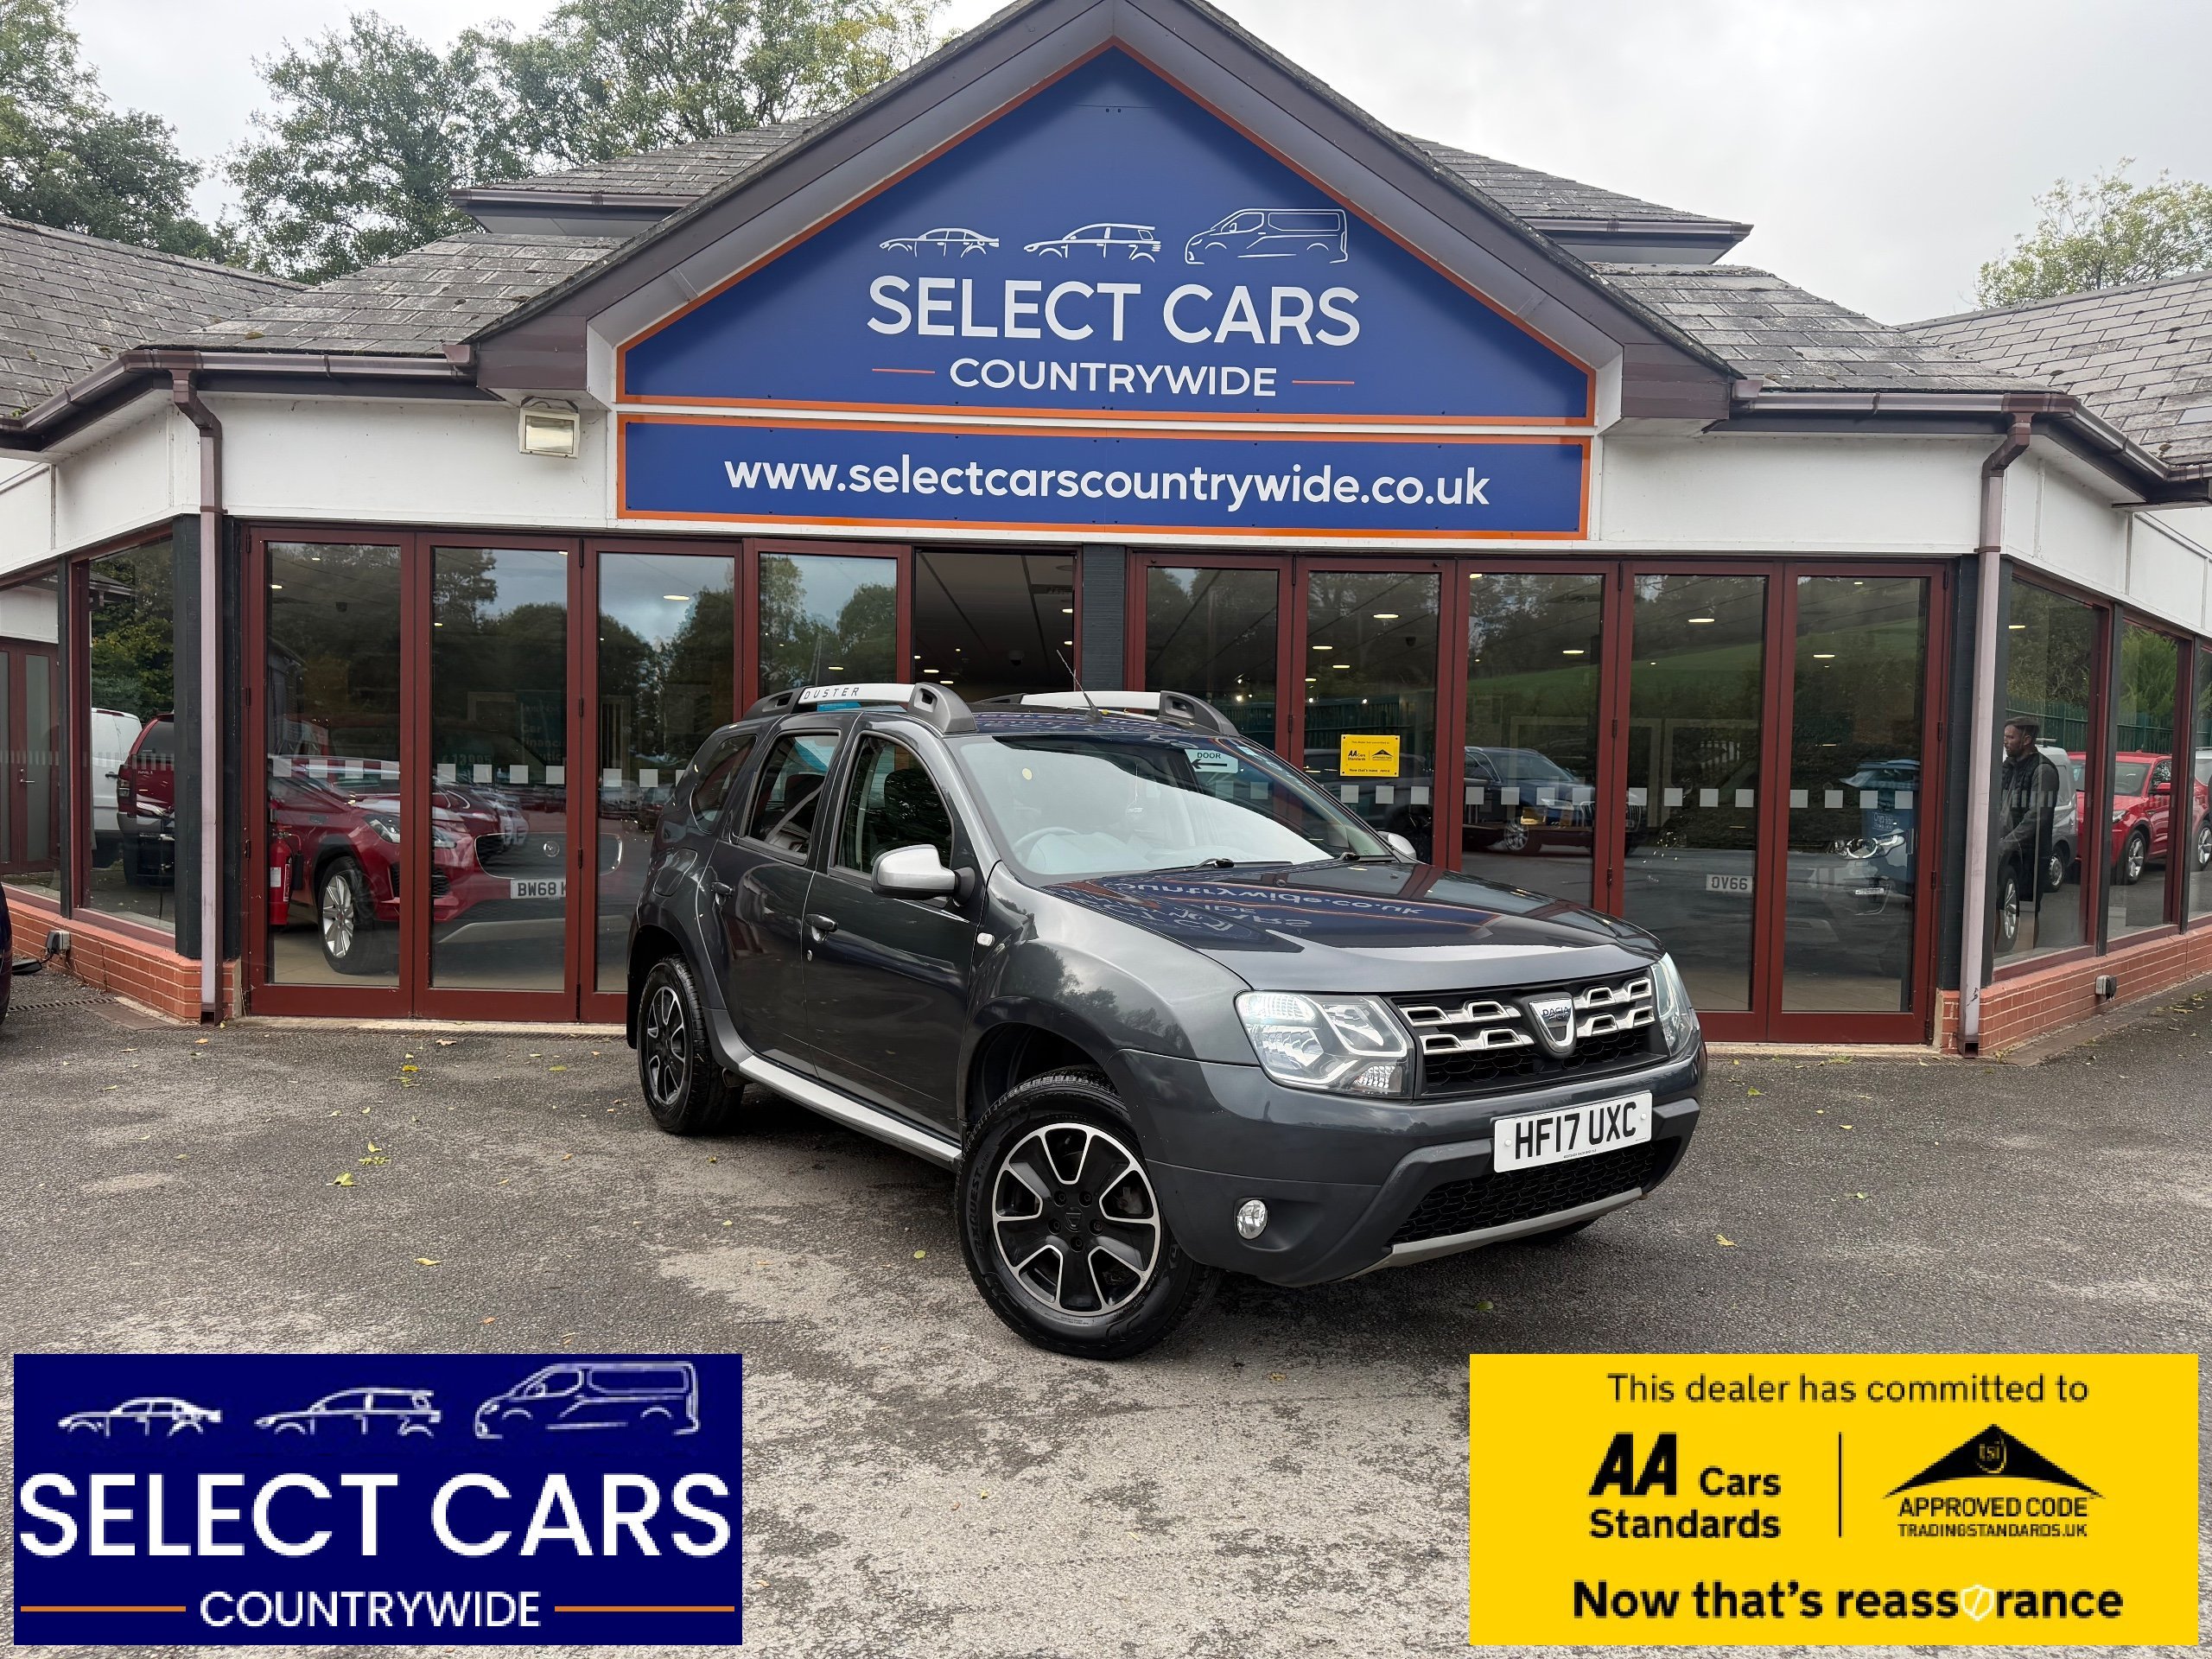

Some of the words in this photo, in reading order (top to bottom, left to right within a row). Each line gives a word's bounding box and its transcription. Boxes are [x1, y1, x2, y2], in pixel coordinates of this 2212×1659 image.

[867, 275, 1141, 341] SELECT
[1163, 284, 1360, 346] CARS
[949, 358, 1277, 397] COUNTRYWIDE
[723, 454, 1491, 512] www.selectcarscountrywide.co.uk
[804, 687, 860, 700] DUSTER
[517, 882, 557, 897] BW68
[1711, 875, 1749, 891] OV66
[1542, 1007, 1570, 1016] DACIA
[1515, 1112, 1580, 1160] HF17
[1588, 1100, 1637, 1146] UXC
